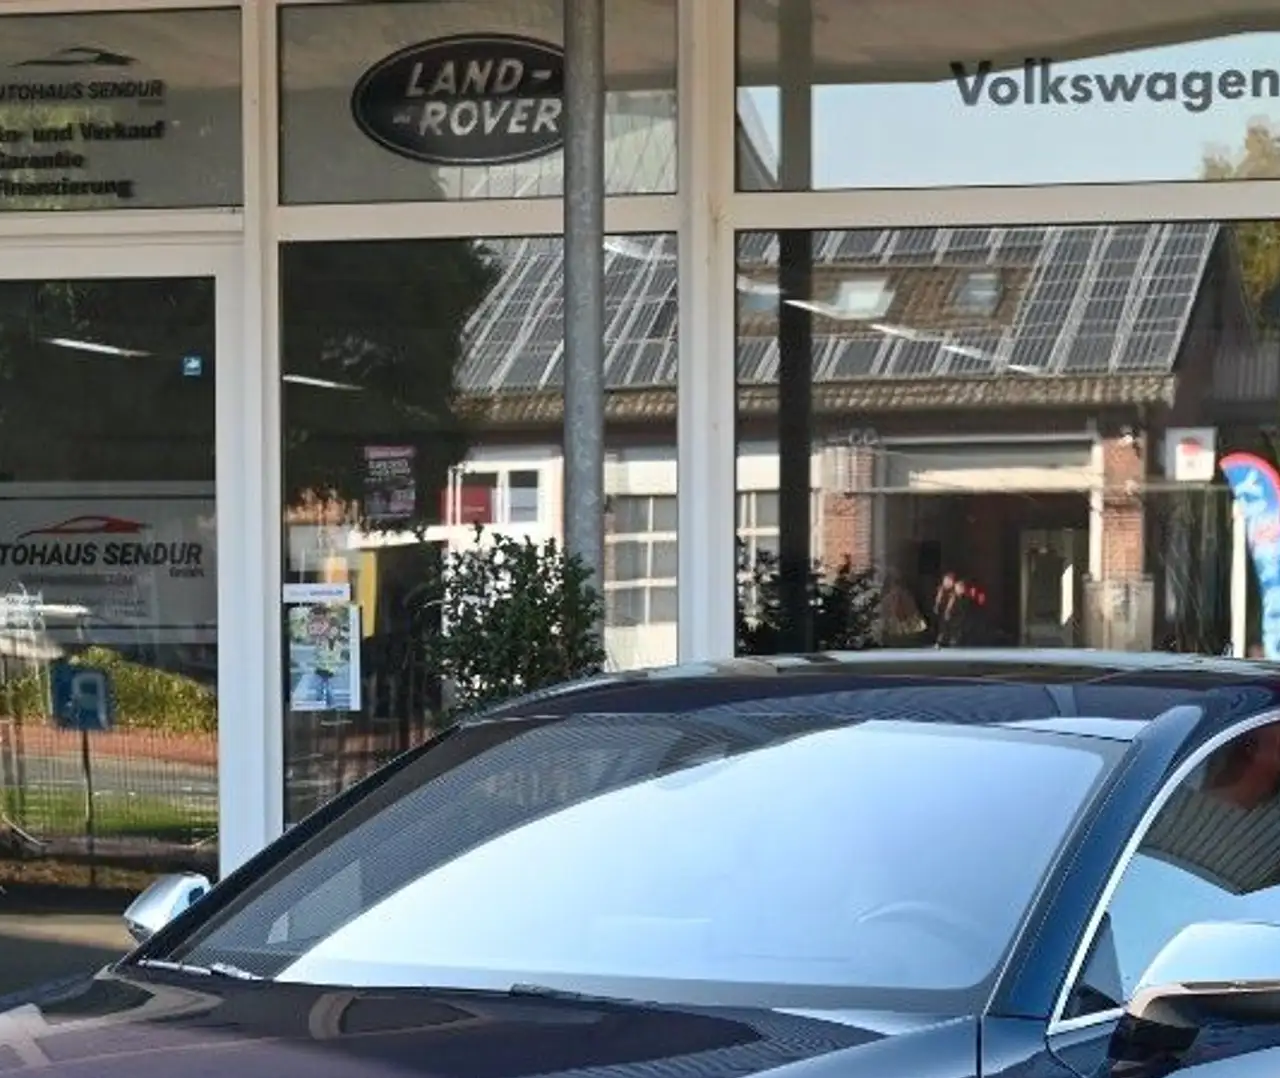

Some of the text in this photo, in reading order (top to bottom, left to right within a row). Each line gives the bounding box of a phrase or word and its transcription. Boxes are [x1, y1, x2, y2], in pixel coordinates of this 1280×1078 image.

[87, 79, 166, 98] SENDUR
[950, 58, 1280, 113] Volkswagen
[33, 123, 73, 142] und
[79, 120, 166, 140] Verkauf
[102, 541, 203, 566] SENDUR
